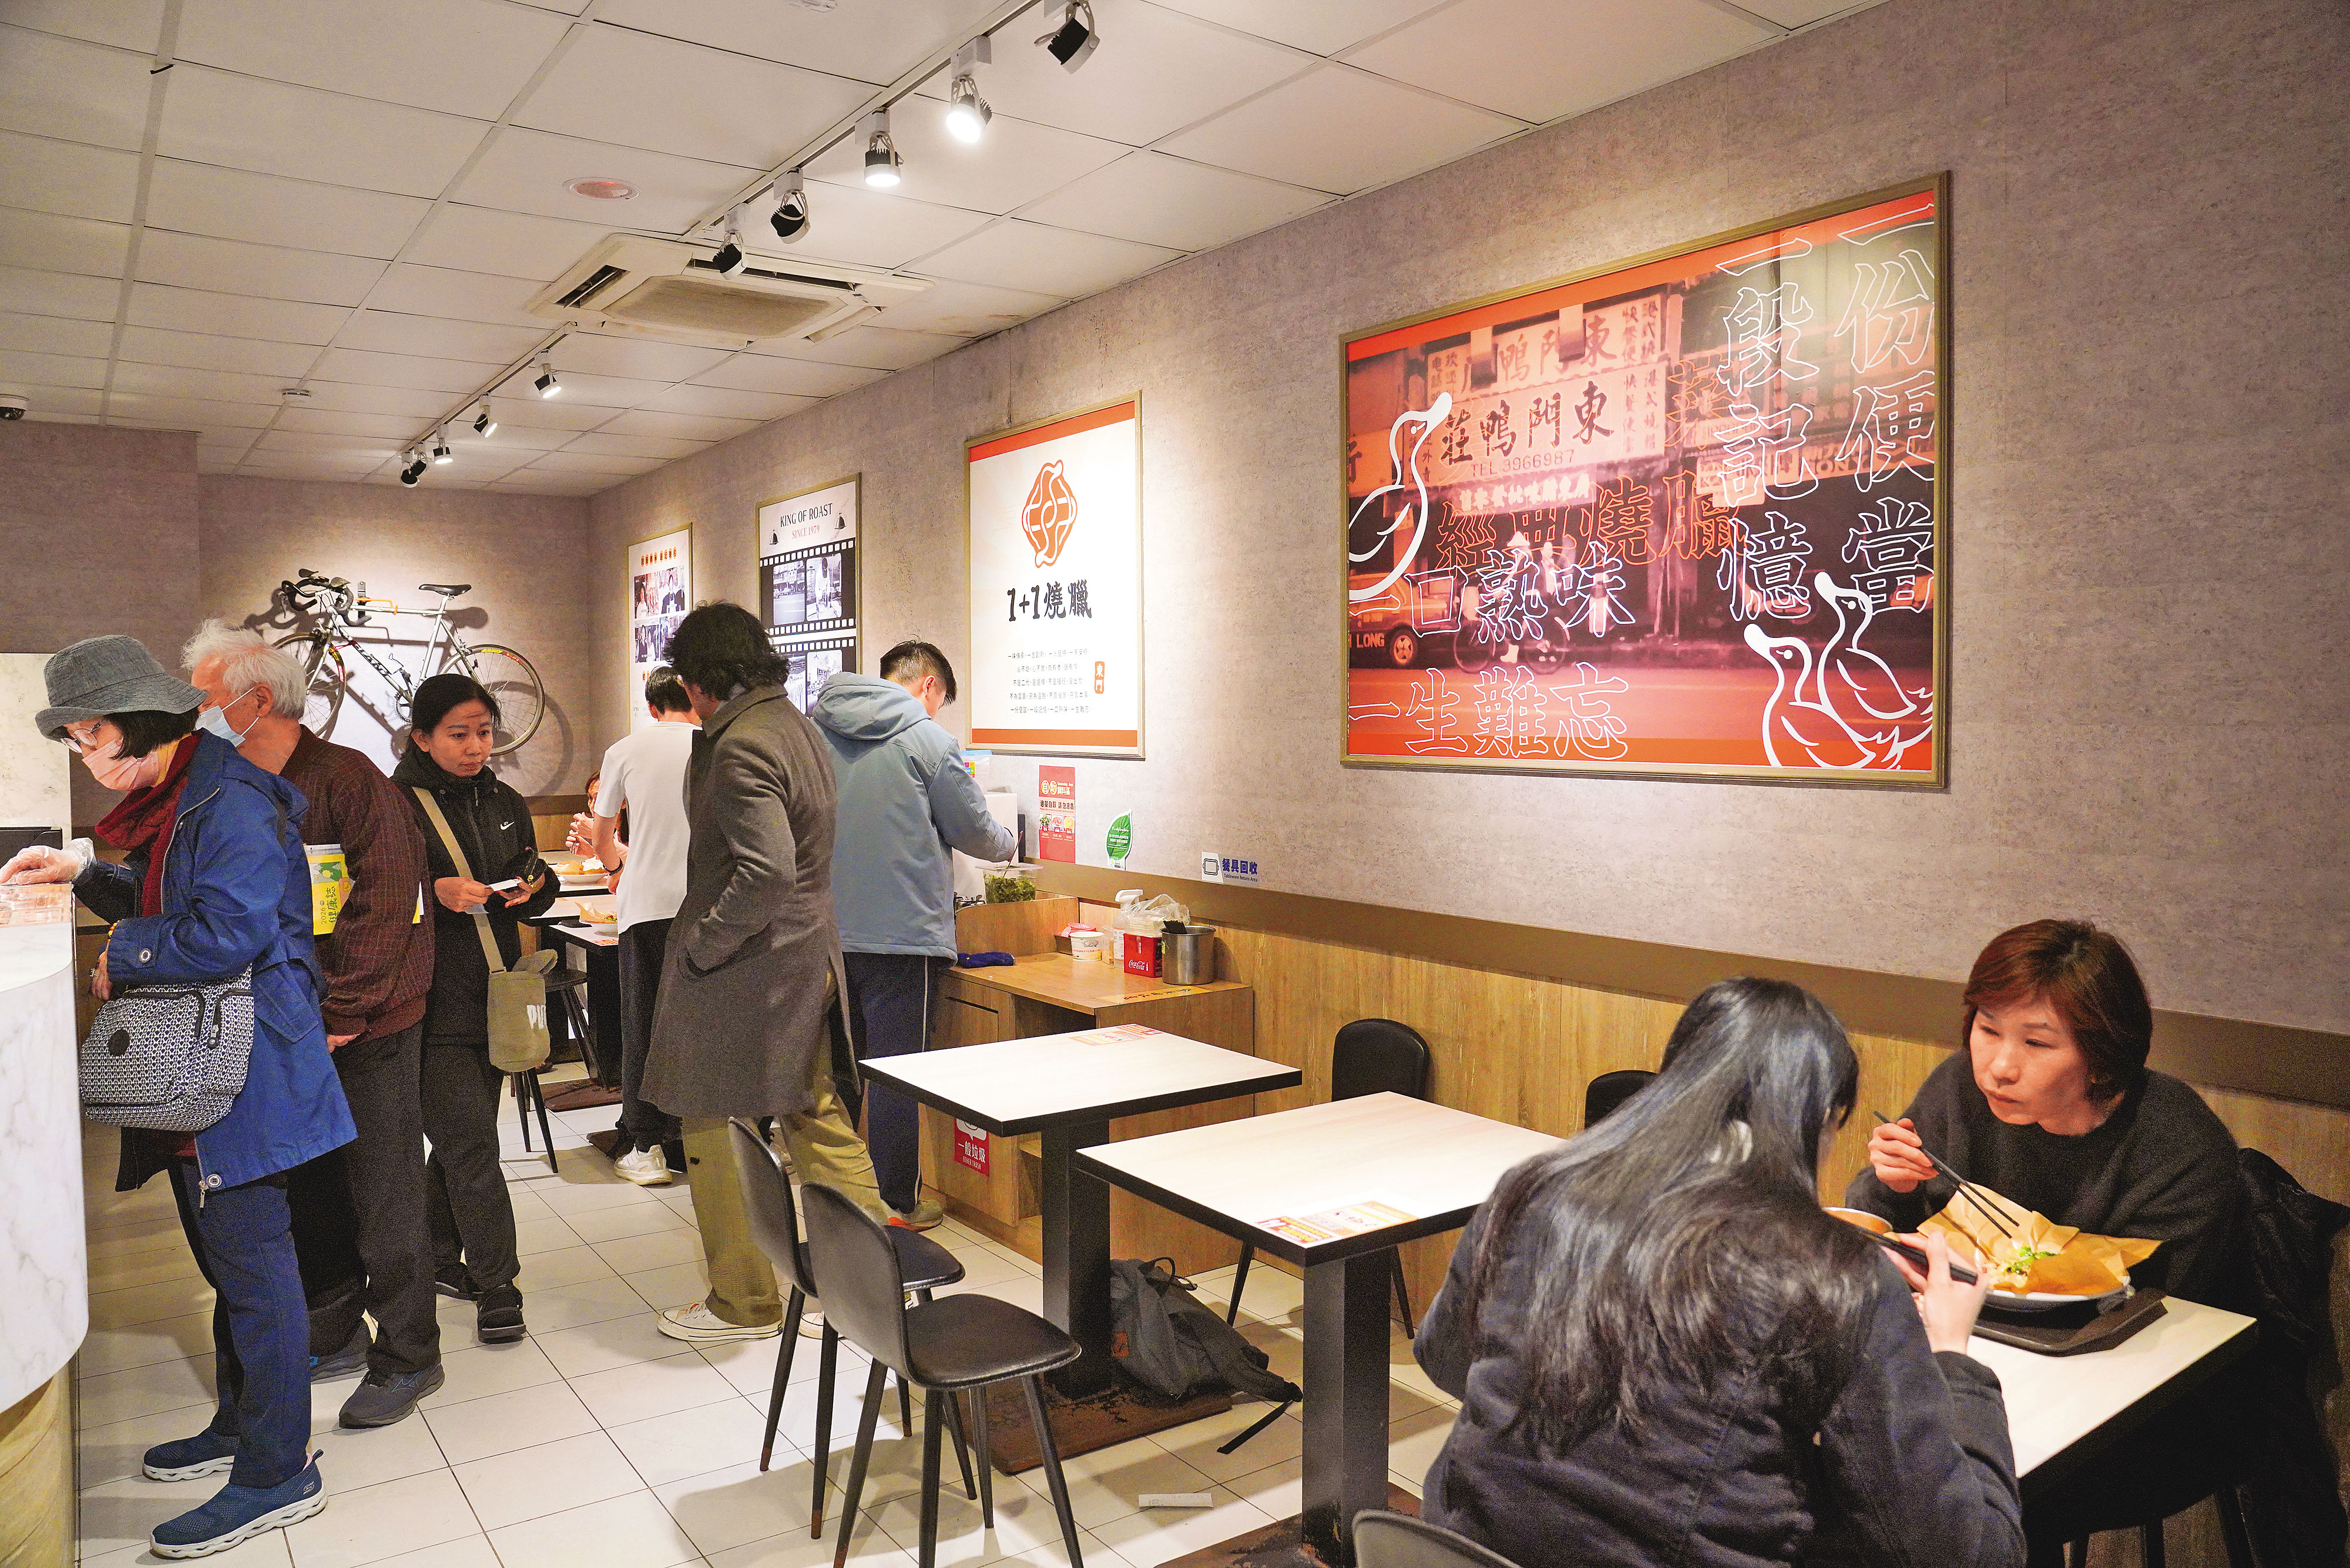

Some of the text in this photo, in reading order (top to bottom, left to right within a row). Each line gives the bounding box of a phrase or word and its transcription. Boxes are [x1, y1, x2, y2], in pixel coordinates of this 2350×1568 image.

[1834, 203, 1935, 616] 一份便當
[1714, 237, 1820, 622] 一段記憶
[1502, 449, 1575, 472] 3966987
[780, 503, 832, 528] KING OF ROAST
[792, 525, 820, 539] SINCE 1979
[1356, 632, 1385, 649] LONG
[1349, 662, 1629, 760] 一生難忘
[1222, 858, 1258, 875] 餐具回收
[958, 1140, 986, 1163] 一般垃圾
[962, 1156, 982, 1170] OTHER TRASH
